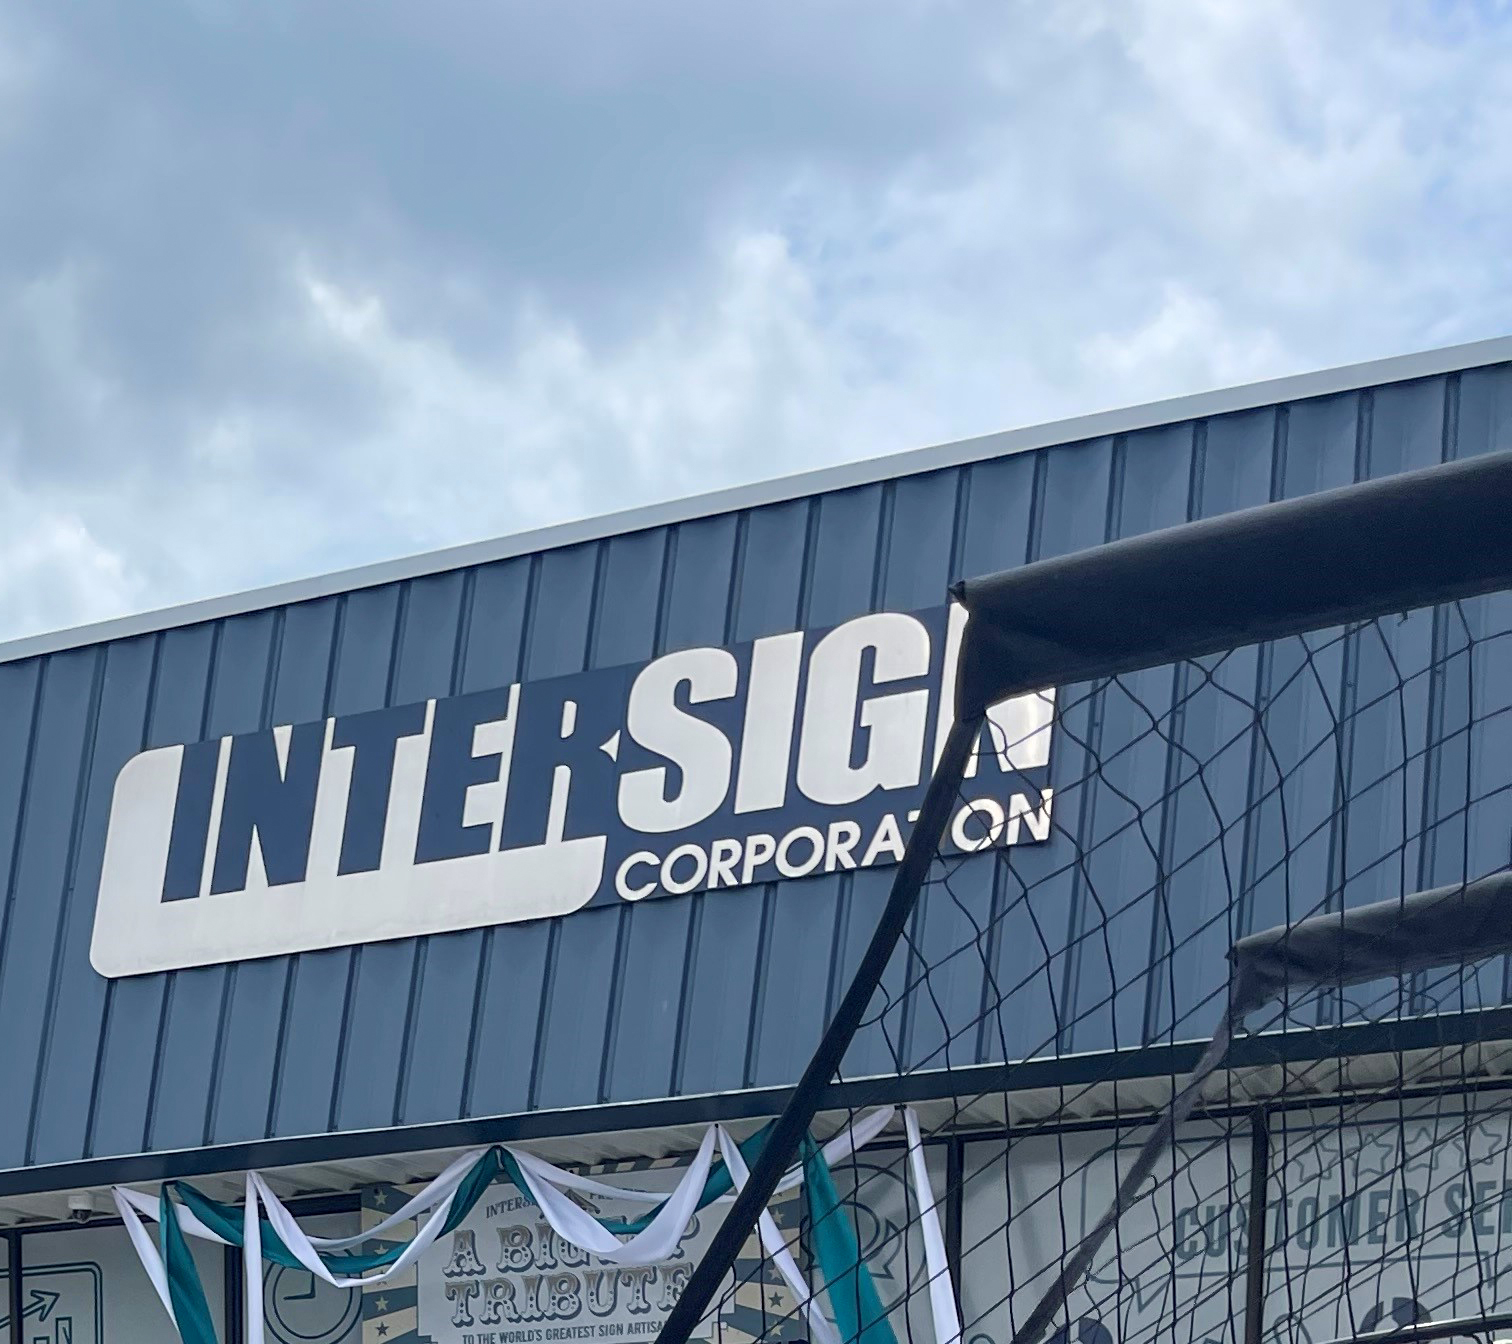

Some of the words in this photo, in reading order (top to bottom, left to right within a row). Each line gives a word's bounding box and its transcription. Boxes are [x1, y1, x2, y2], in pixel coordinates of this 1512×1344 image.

[614, 788, 1054, 902] CORPORAON
[443, 1229, 487, 1277] A
[444, 1263, 694, 1328] TRIBUTE
[499, 1328, 543, 1344] WORLD'S
[545, 1325, 596, 1341] GREATEST
[598, 1322, 624, 1338] SIGN
[627, 1319, 666, 1335] ARTISA
